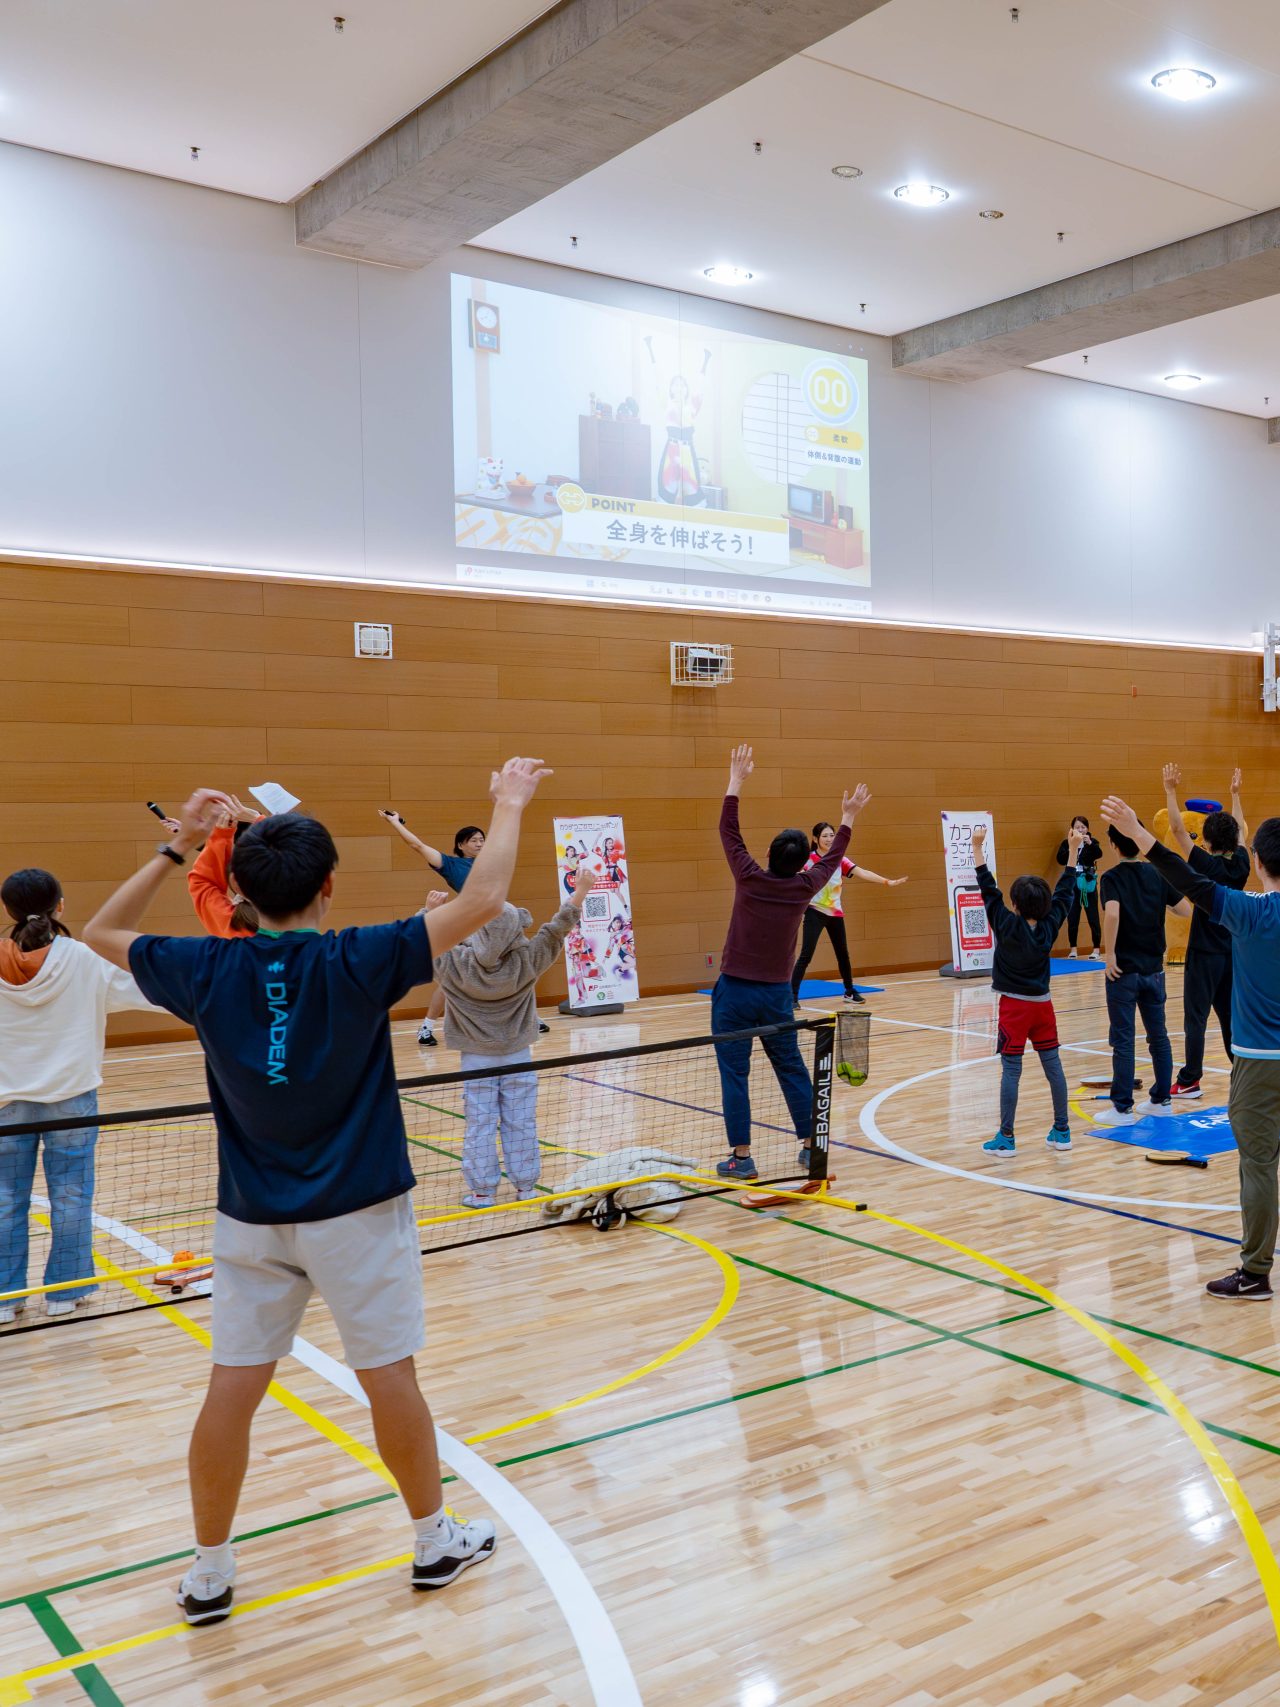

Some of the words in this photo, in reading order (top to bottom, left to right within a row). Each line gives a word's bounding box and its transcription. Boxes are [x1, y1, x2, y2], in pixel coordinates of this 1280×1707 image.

[814, 375, 847, 408] 00
[591, 497, 636, 513] POINT
[265, 982, 289, 1085] DIADEM
[816, 1072, 830, 1135] BAGAIL
